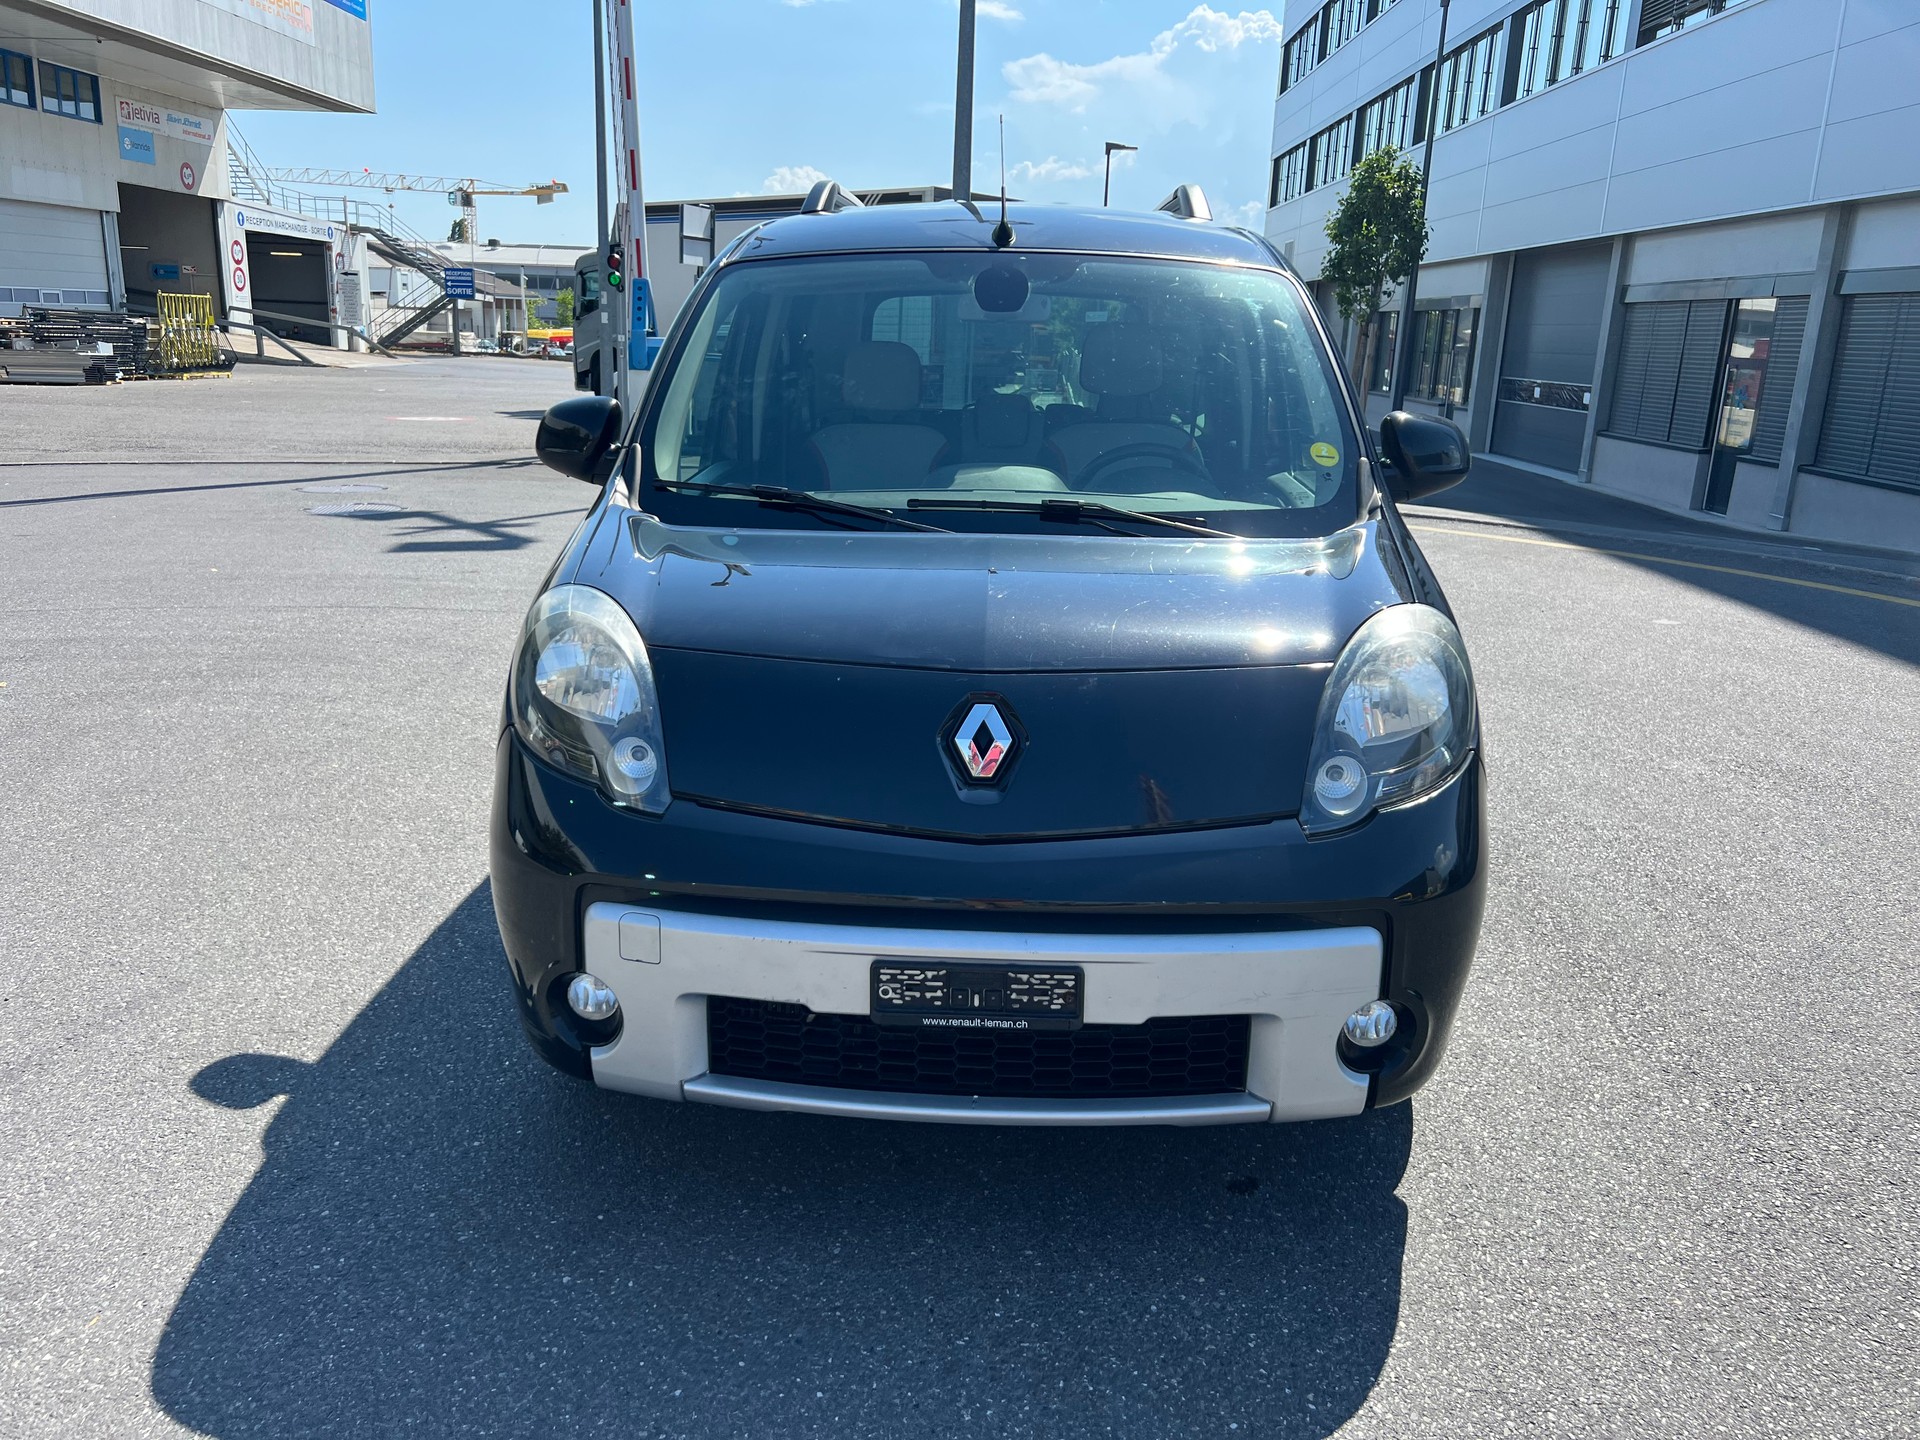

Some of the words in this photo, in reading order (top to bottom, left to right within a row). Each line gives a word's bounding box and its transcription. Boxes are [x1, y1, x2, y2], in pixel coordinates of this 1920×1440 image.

[131, 103, 160, 124] jetivia
[245, 215, 274, 227] RECEPTION
[311, 226, 327, 236] SORTIE
[446, 287, 473, 295] SORTIE
[922, 1017, 1028, 1028] www.renault-leman.ch
